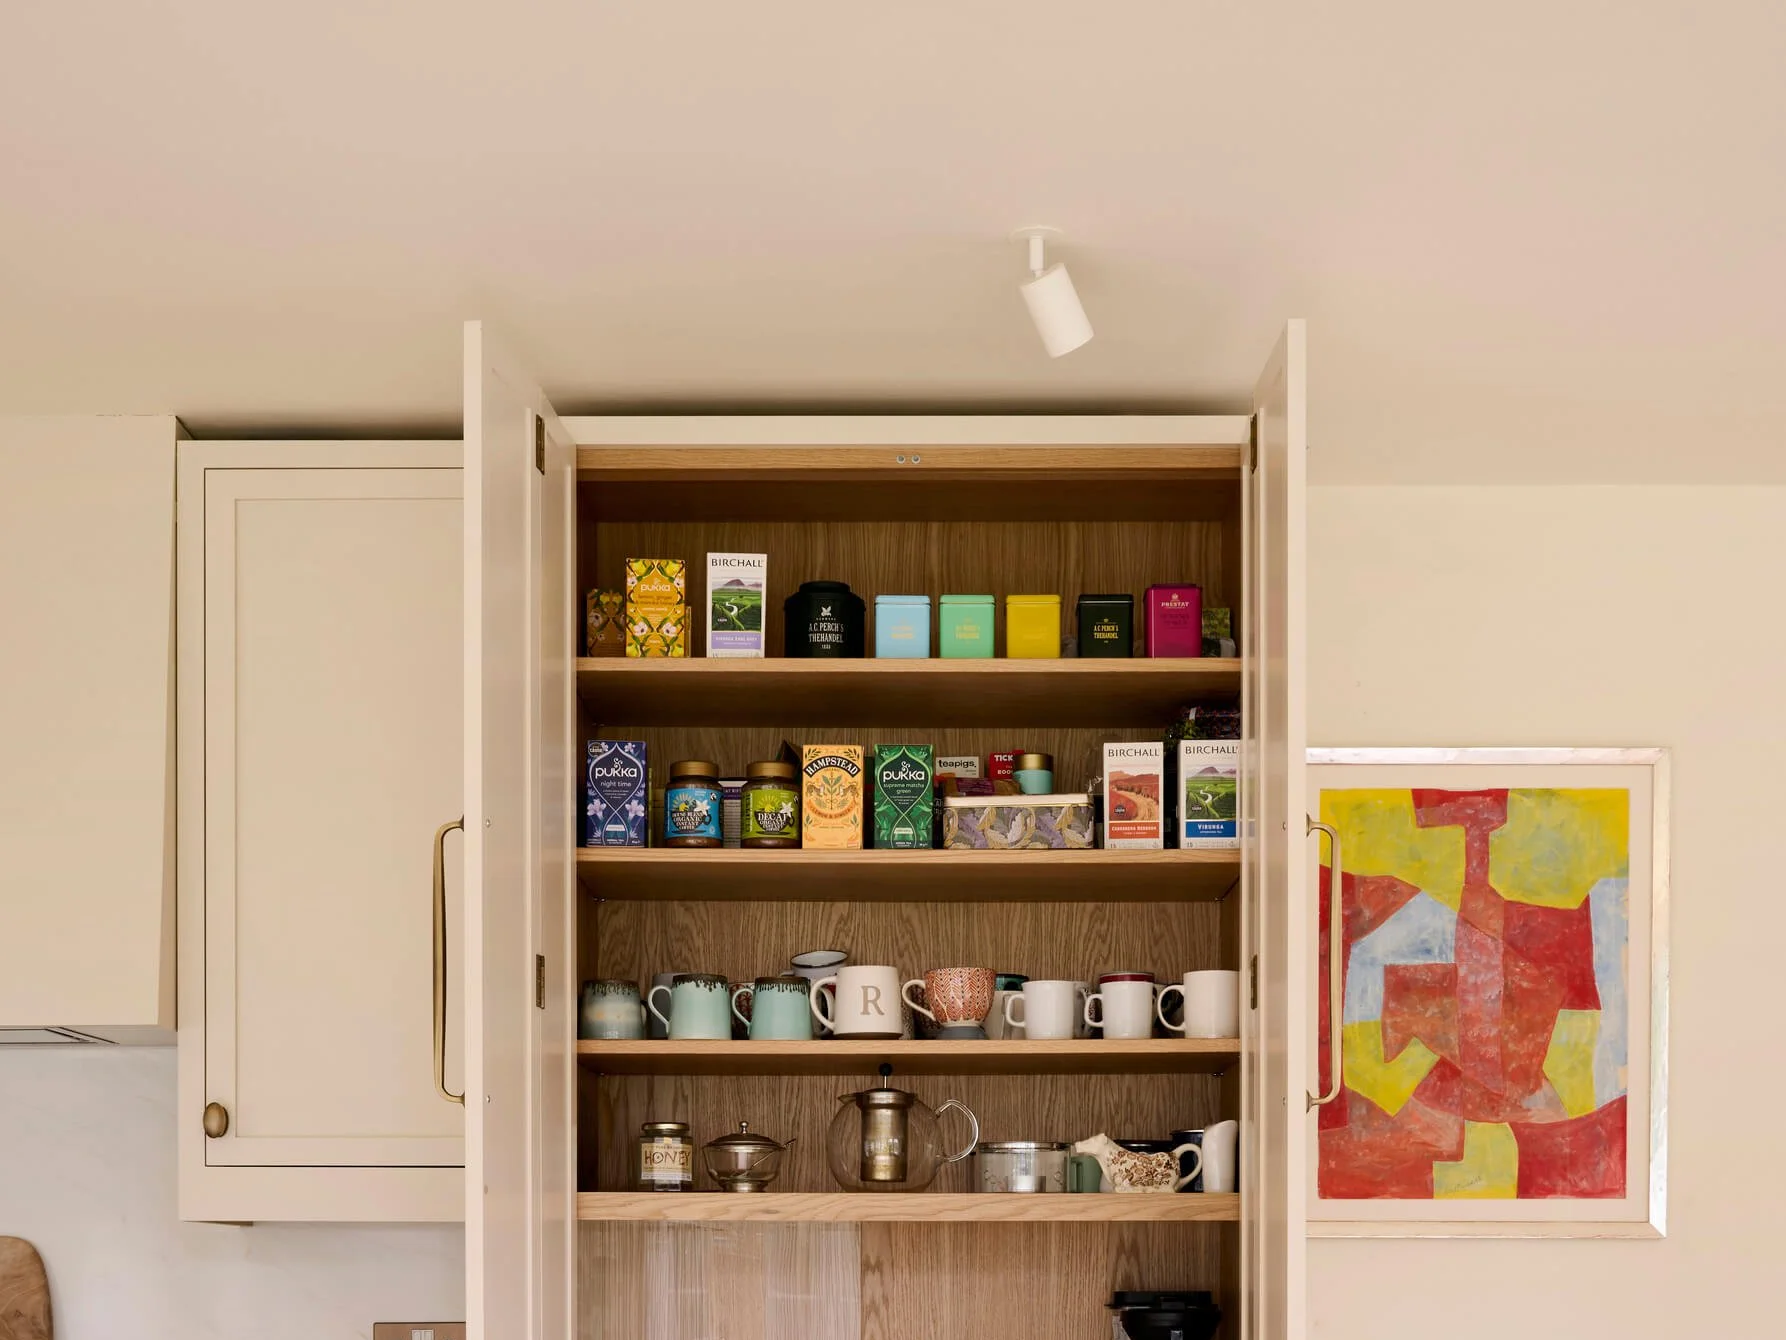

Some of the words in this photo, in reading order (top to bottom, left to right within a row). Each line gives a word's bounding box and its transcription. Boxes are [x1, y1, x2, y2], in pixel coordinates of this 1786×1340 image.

[711, 558, 763, 568] BIRCHALL
[640, 583, 671, 593] pukka
[819, 622, 845, 632] PERCH'S
[808, 633, 844, 643] THEHANDEL
[1108, 748, 1160, 758] BIRCHALL
[1185, 745, 1238, 755] BIRCHALL
[994, 754, 1014, 762] TICK
[805, 756, 859, 776] HAMPSTEAD
[938, 759, 977, 769] teapigs.
[595, 767, 637, 779] pukka
[883, 770, 925, 782] pukka
[617, 780, 632, 788] time
[860, 986, 885, 1015] R
[644, 1150, 691, 1167] HONEY
